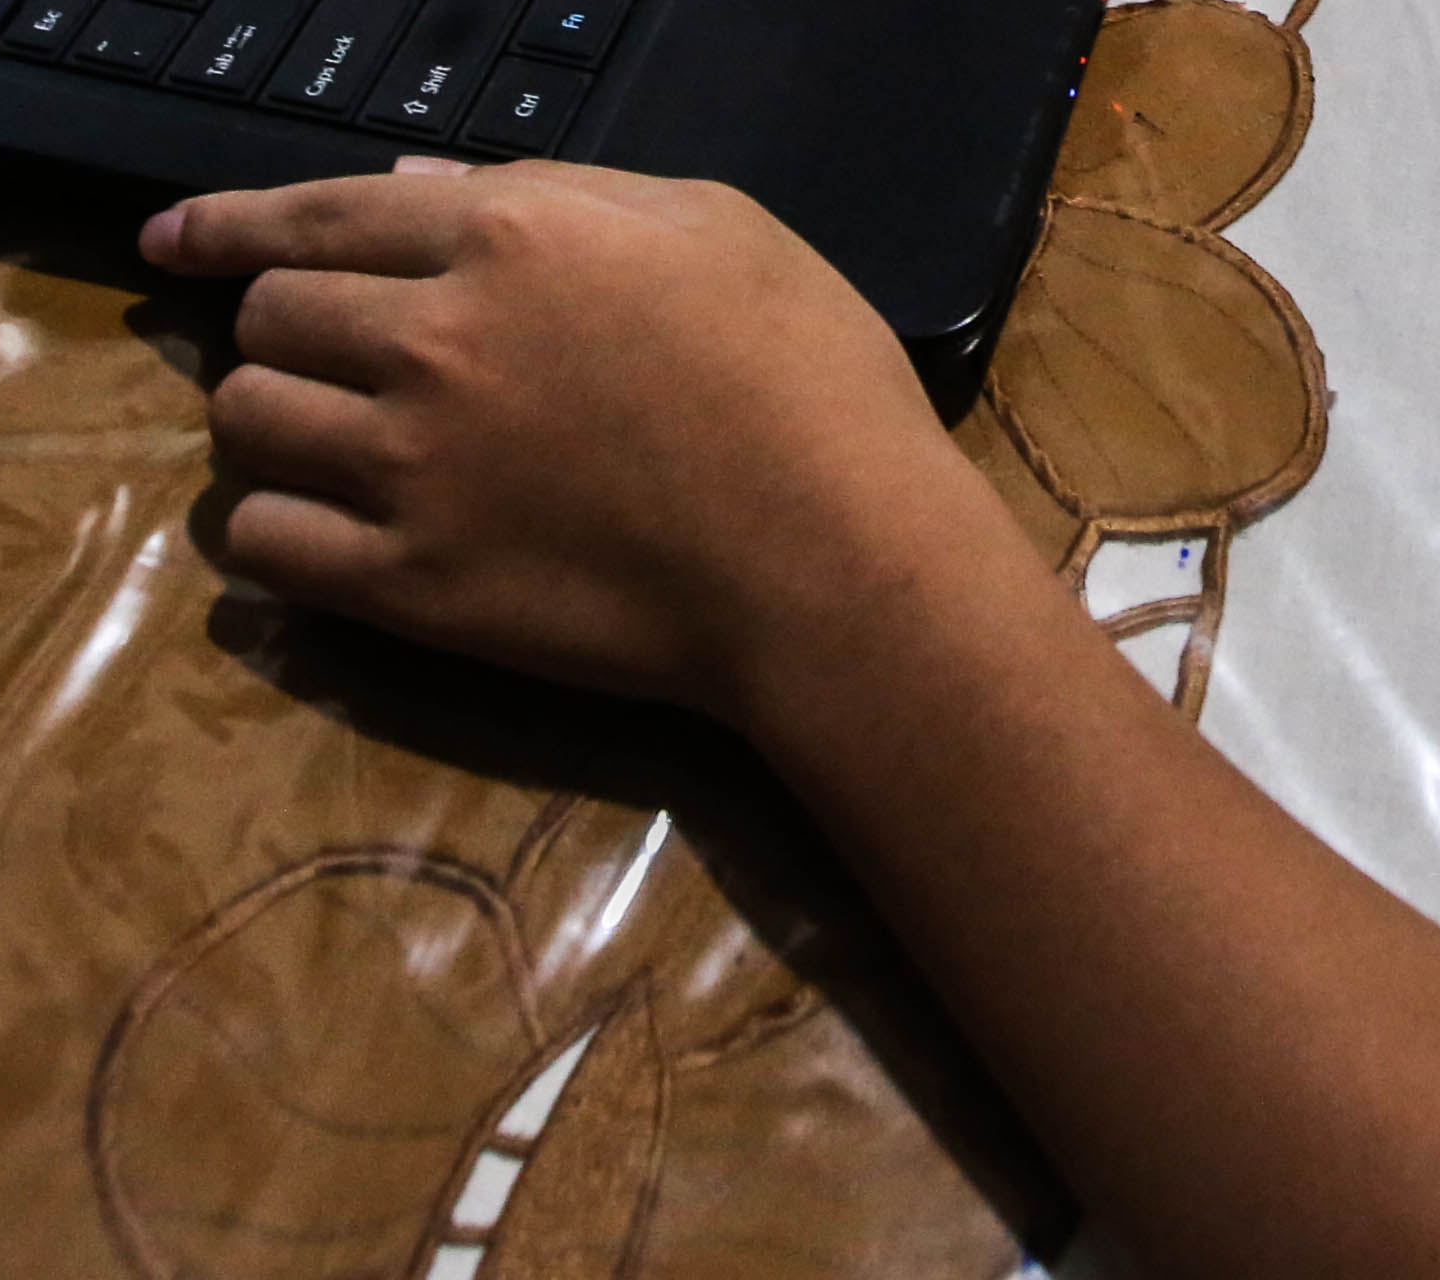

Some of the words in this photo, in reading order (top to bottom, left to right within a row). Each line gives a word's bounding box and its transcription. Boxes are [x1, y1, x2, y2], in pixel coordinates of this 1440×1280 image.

[34, 9, 62, 31] Esc
[561, 12, 586, 30] Fn
[205, 53, 235, 77] Tab
[304, 66, 338, 98] Caps
[323, 34, 356, 66] Lock
[419, 62, 455, 96] Shift
[515, 92, 540, 118] Ctrl
